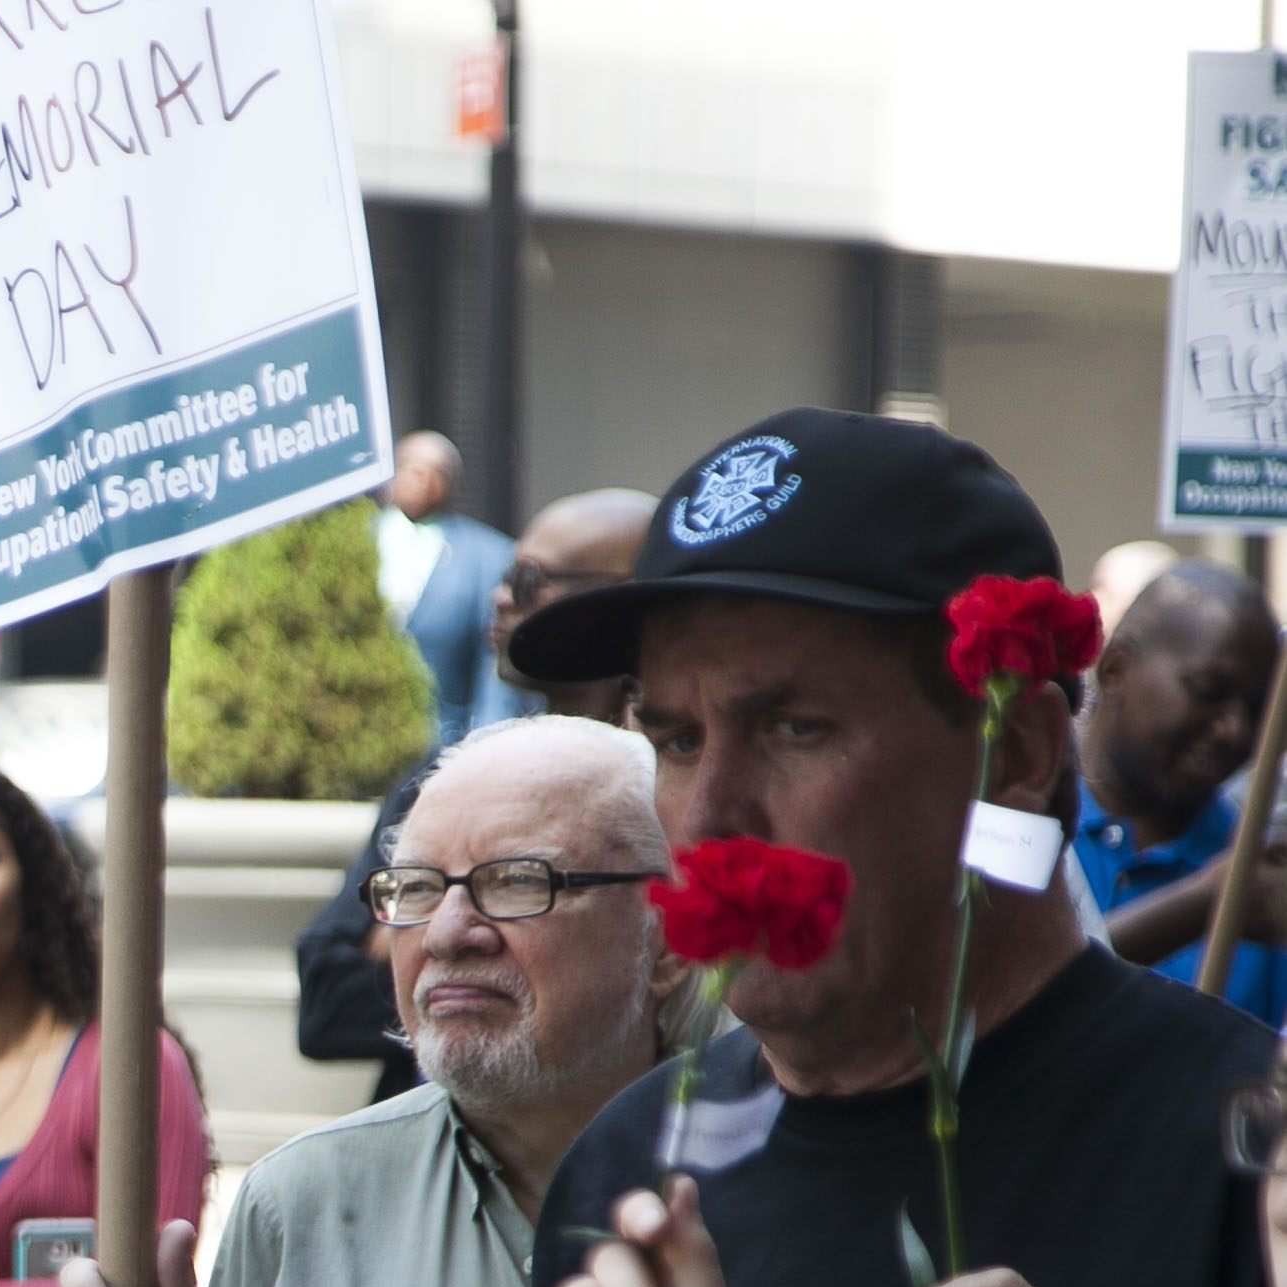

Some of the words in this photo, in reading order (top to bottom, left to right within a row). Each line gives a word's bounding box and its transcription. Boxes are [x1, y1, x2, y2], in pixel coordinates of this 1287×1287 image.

[4, 195, 162, 391] DAY
[38, 440, 87, 497] York
[81, 383, 258, 471] Committee
[261, 361, 309, 409] for
[105, 452, 221, 522] Safety
[227, 437, 249, 479] &
[252, 395, 359, 469] Health
[700, 435, 799, 477] INTERNATIONAL
[765, 473, 803, 511] GUILD
